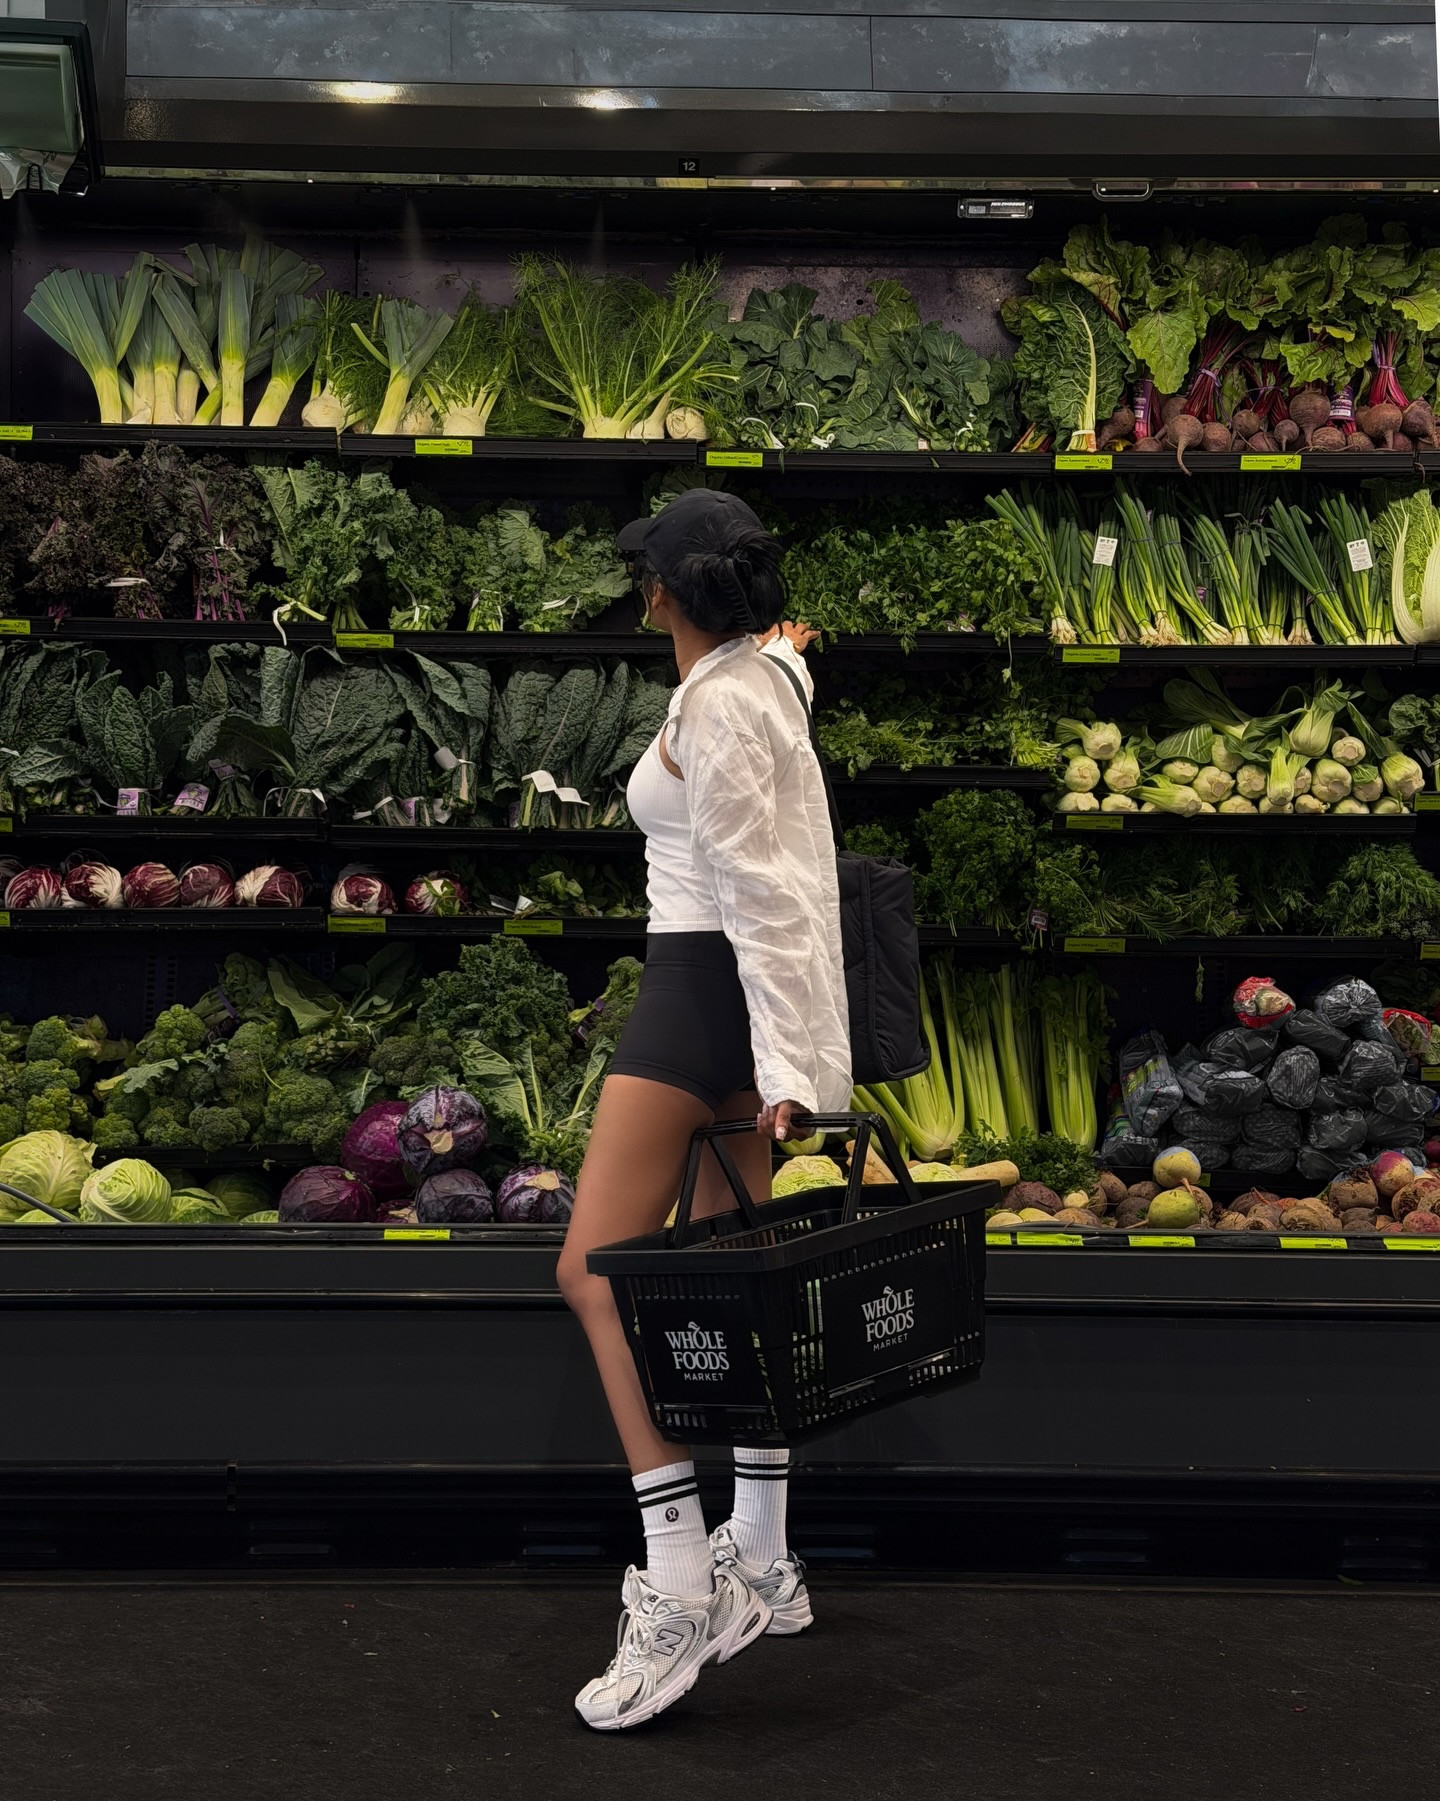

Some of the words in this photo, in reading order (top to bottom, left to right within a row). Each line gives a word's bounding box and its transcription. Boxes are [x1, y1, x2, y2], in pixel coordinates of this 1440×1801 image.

[682, 161, 696, 171] 12
[861, 1287, 915, 1323] WHOLE
[865, 1309, 915, 1343] FOODS
[664, 1326, 728, 1350] WHOLE
[873, 1332, 909, 1352] MARKET
[672, 1351, 730, 1371] FOODS
[684, 1372, 724, 1382] MARKET
[653, 1628, 684, 1657] N
